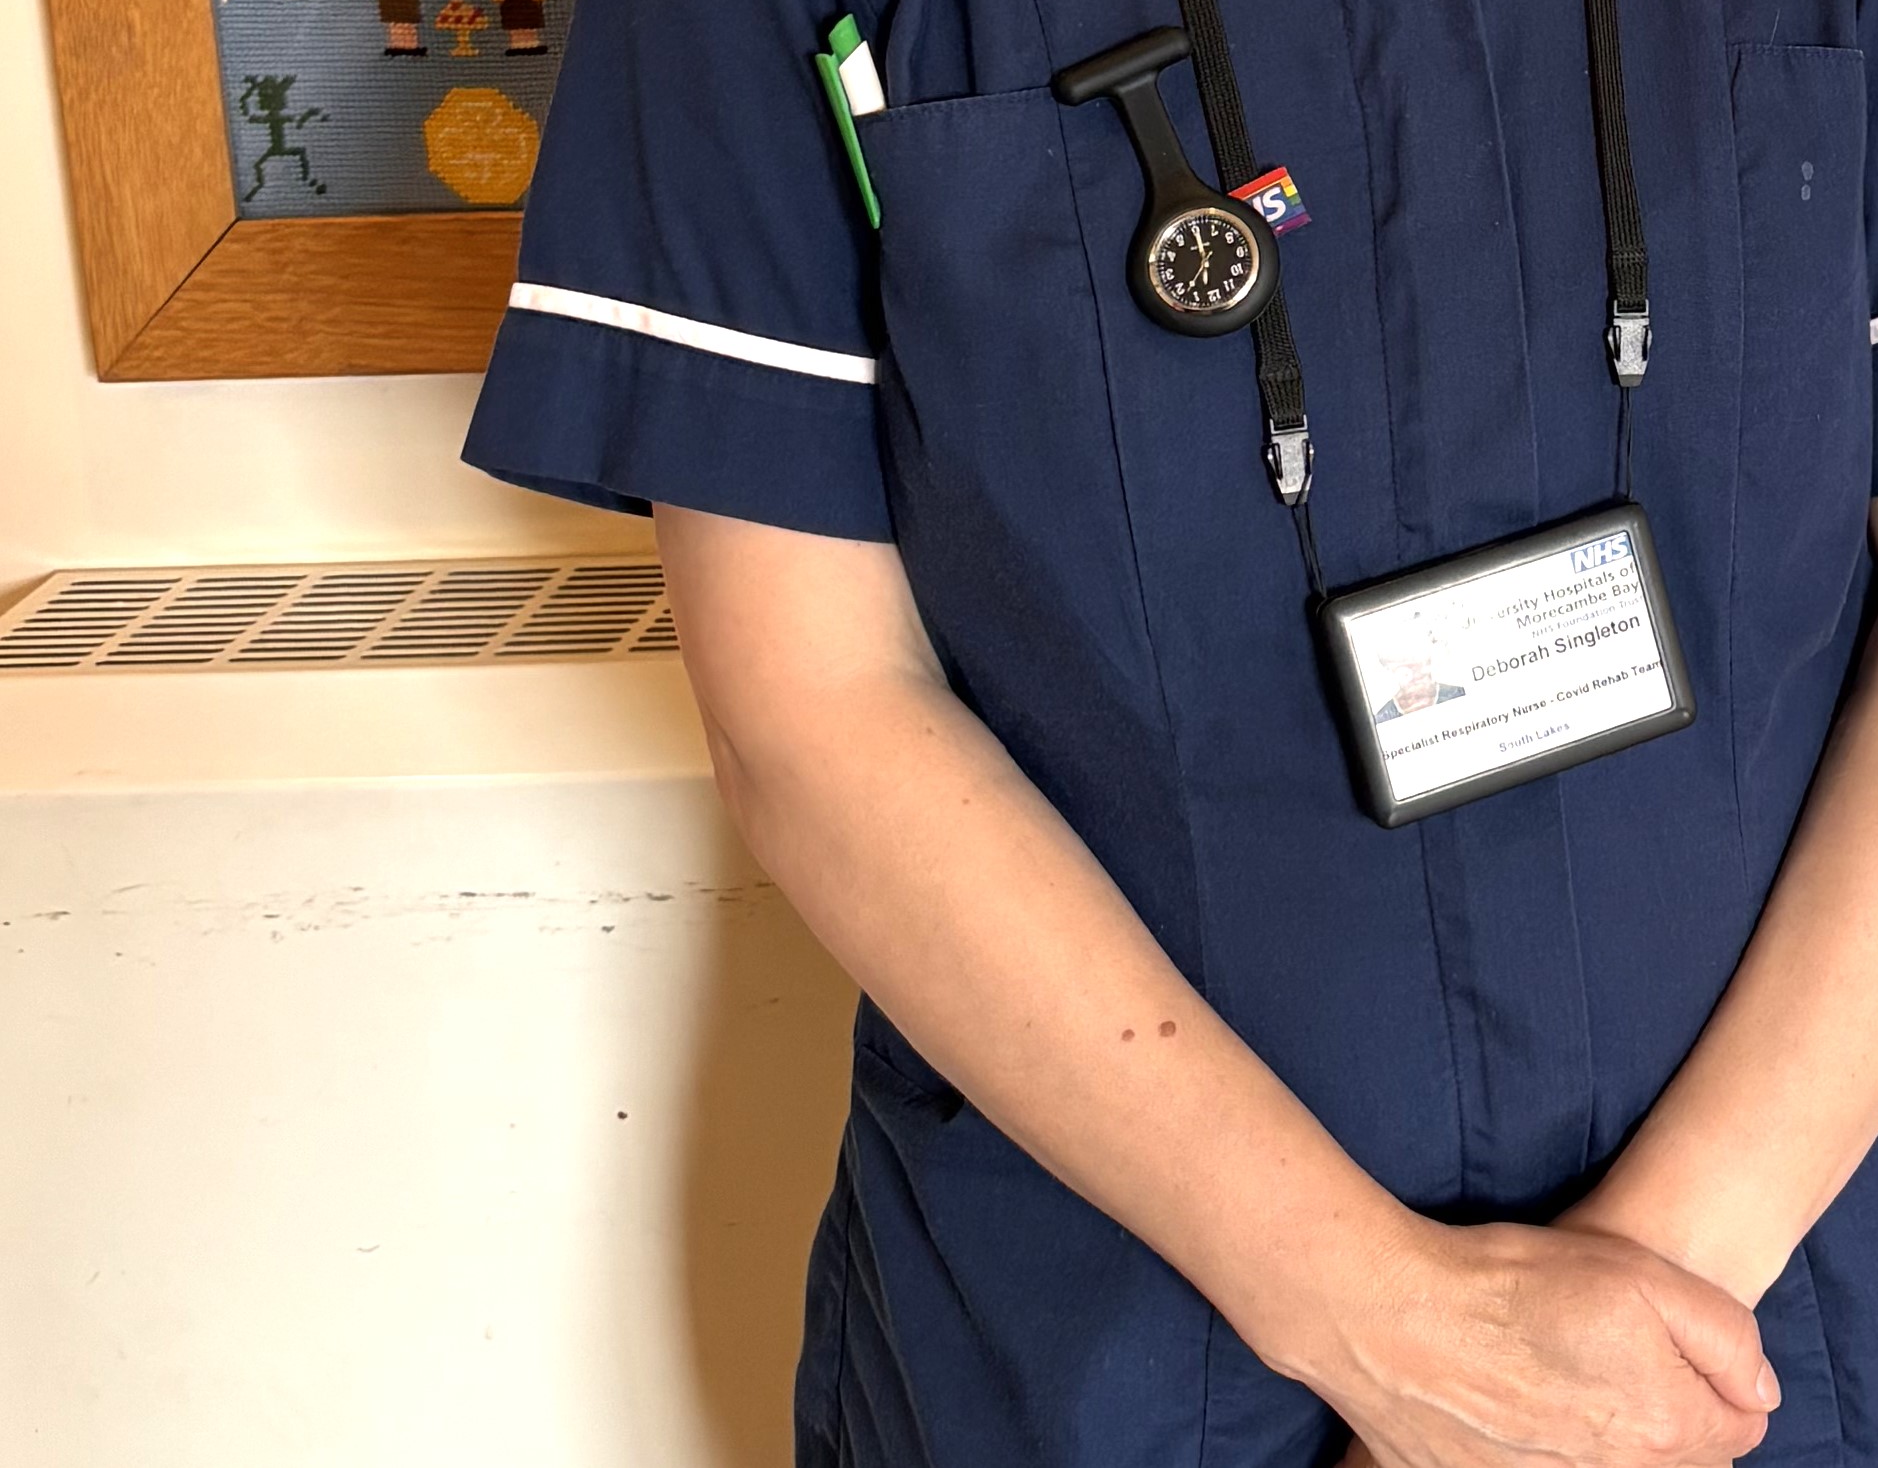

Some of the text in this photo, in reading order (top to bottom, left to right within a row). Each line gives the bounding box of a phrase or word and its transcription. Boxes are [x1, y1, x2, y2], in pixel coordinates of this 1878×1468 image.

[1571, 535, 1631, 575] NHS
[1516, 580, 1641, 629] Morecambe Bay
[1544, 570, 1615, 603] Hospitals
[1472, 614, 1641, 682] Deborah Singleton
[1441, 712, 1509, 742] Respiratory
[1512, 699, 1547, 717] Nurse
[1556, 683, 1590, 703] Covid
[1592, 670, 1630, 691] Rehab
